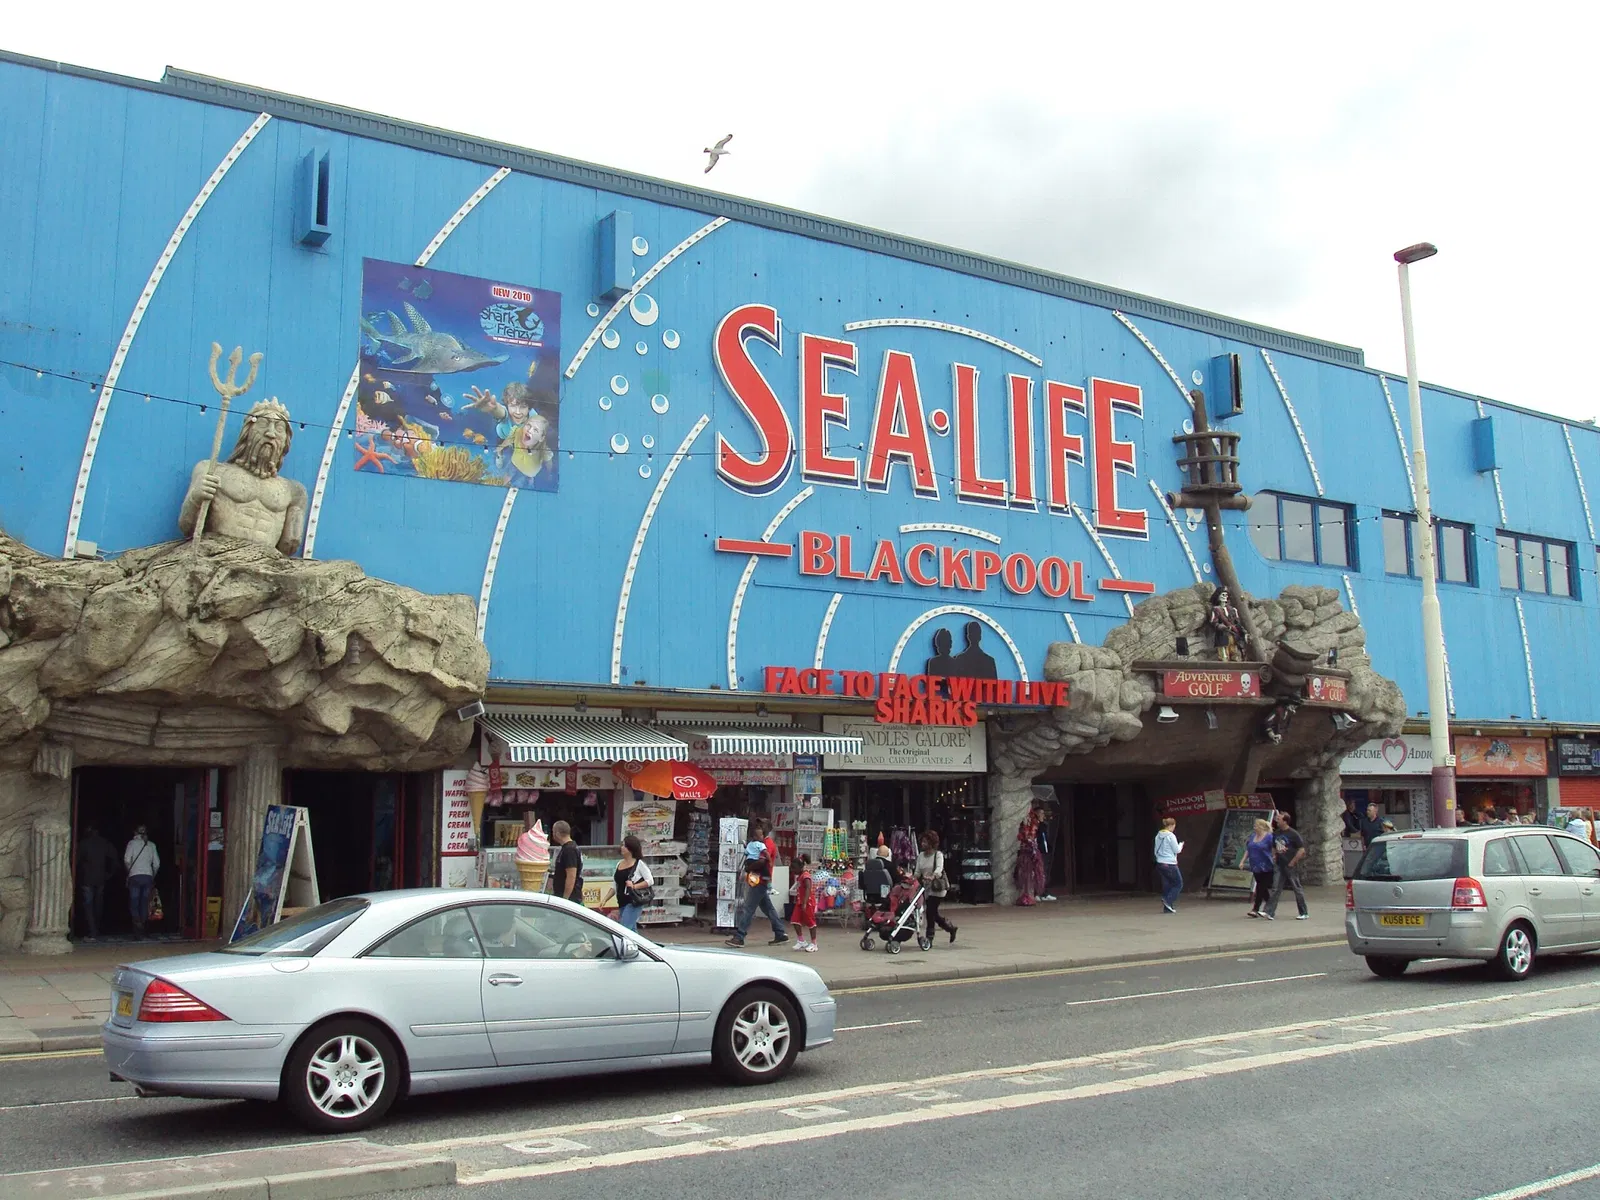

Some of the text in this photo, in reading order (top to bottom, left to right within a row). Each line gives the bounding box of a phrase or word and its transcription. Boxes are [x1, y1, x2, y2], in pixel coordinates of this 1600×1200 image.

[493, 287, 531, 301] NEW 2010
[480, 308, 515, 326] Shark
[498, 323, 533, 339] Frenzy
[799, 530, 1095, 601] BLACKPOOL
[1171, 671, 1233, 685] ADVENTURE
[765, 666, 1070, 707] FACE TO FACE WITH LIVE
[1188, 683, 1223, 697] GOLF
[1329, 688, 1345, 701] GOLF
[875, 697, 978, 728] SHARKS
[915, 732, 967, 747] GALORE
[902, 748, 930, 757] Original
[1346, 749, 1382, 759] ERFUME
[863, 756, 954, 765] HAND CARVED CANDLES
[450, 800, 469, 808] WITH
[1165, 795, 1204, 807] INDOOR
[448, 810, 470, 818] FRESH
[447, 821, 471, 829] CREAM
[1383, 915, 1421, 925] KU58 ECE
